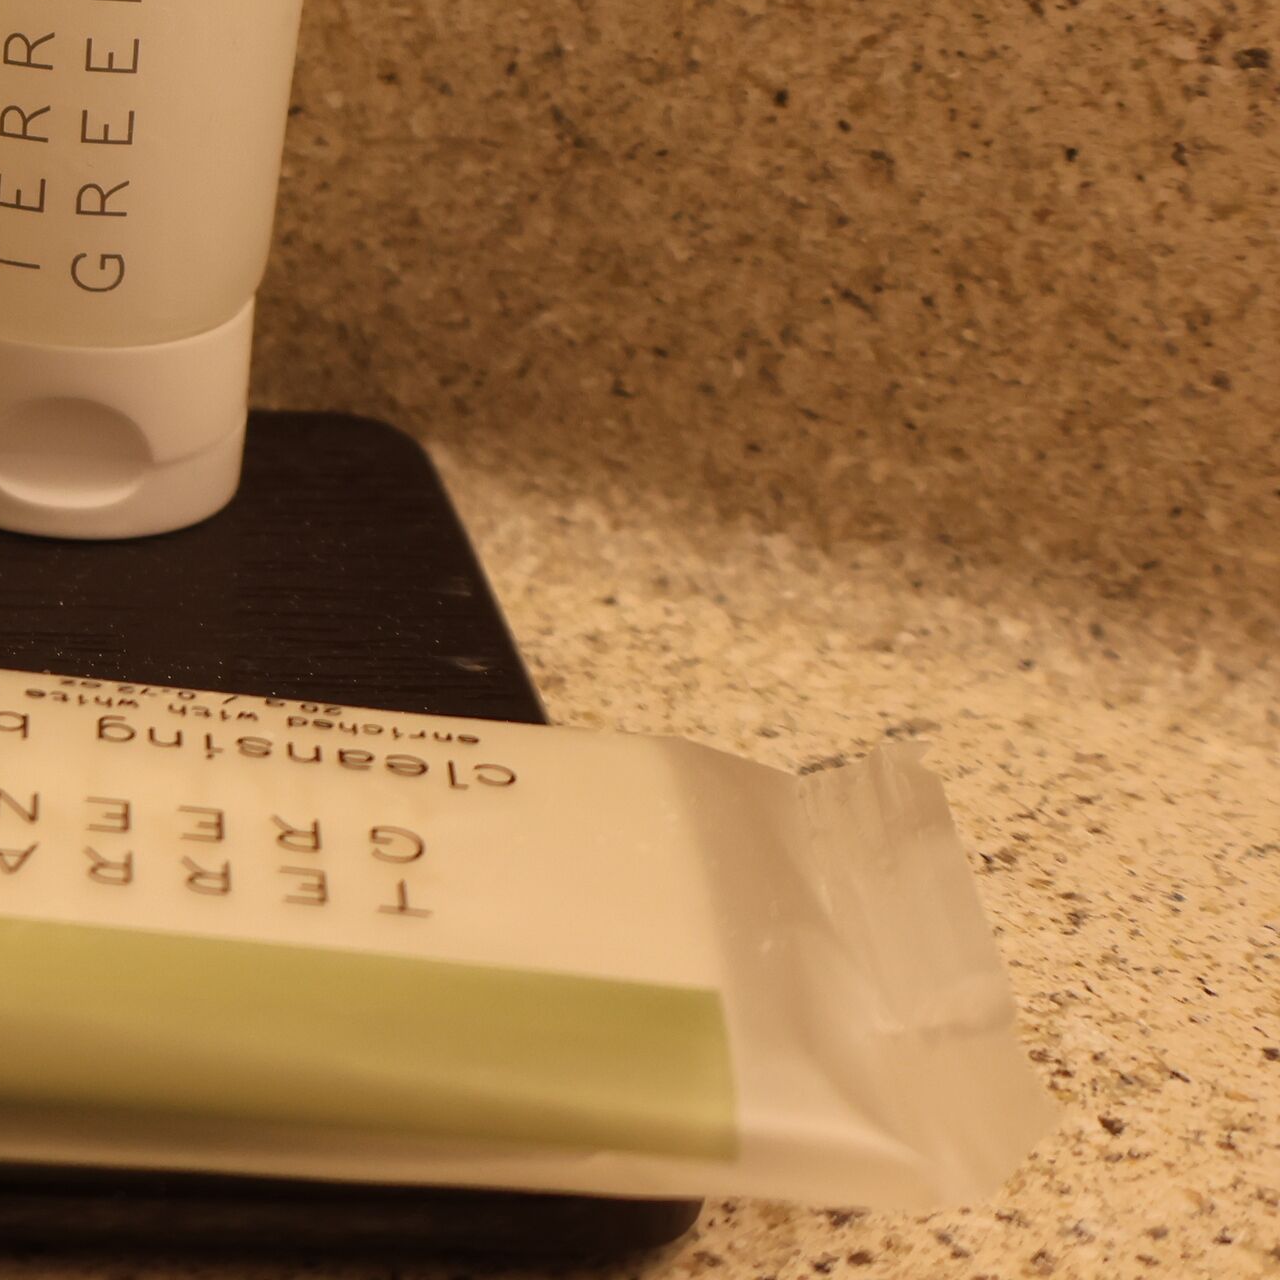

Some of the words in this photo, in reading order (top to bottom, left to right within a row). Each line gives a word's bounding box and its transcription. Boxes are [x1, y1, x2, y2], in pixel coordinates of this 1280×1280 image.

[24, 687, 139, 710] white
[167, 701, 258, 724] with
[286, 715, 479, 746] enriched
[94, 717, 517, 792] cleansing
